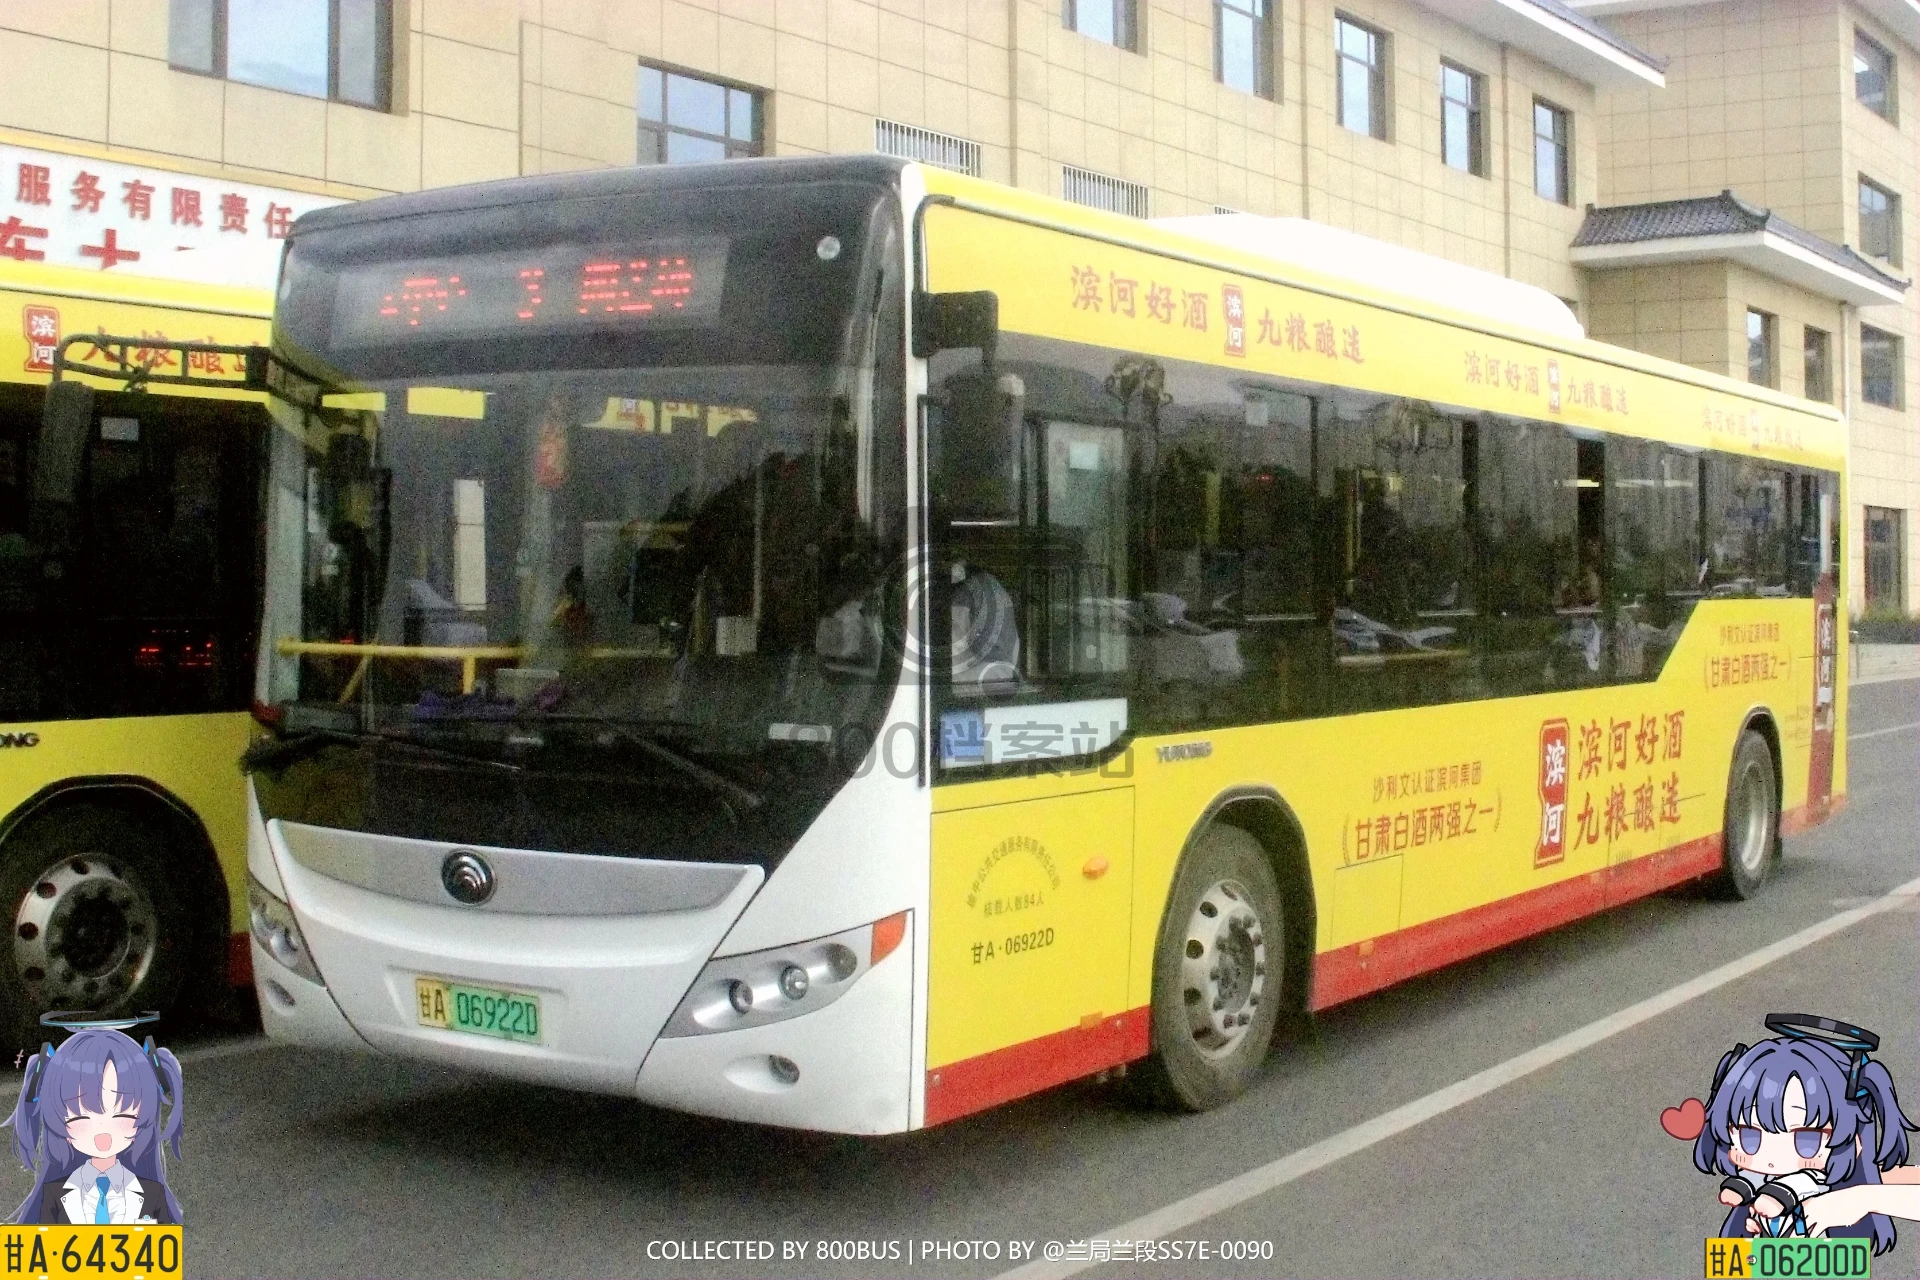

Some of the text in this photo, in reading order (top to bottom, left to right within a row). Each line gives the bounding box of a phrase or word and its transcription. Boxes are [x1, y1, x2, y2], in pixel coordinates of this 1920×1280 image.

[1069, 264, 1365, 364] 滨河好酒 滨河 九粮酿造
[1464, 349, 1540, 396] 滨河好酒
[1577, 710, 1686, 781] 滨河好酒
[1373, 760, 1482, 803] 沙利文认证滨河集团
[1541, 739, 1566, 845] 滨河
[1573, 772, 1684, 852] 九粮酿造
[971, 927, 1055, 965] 甘A·06922D
